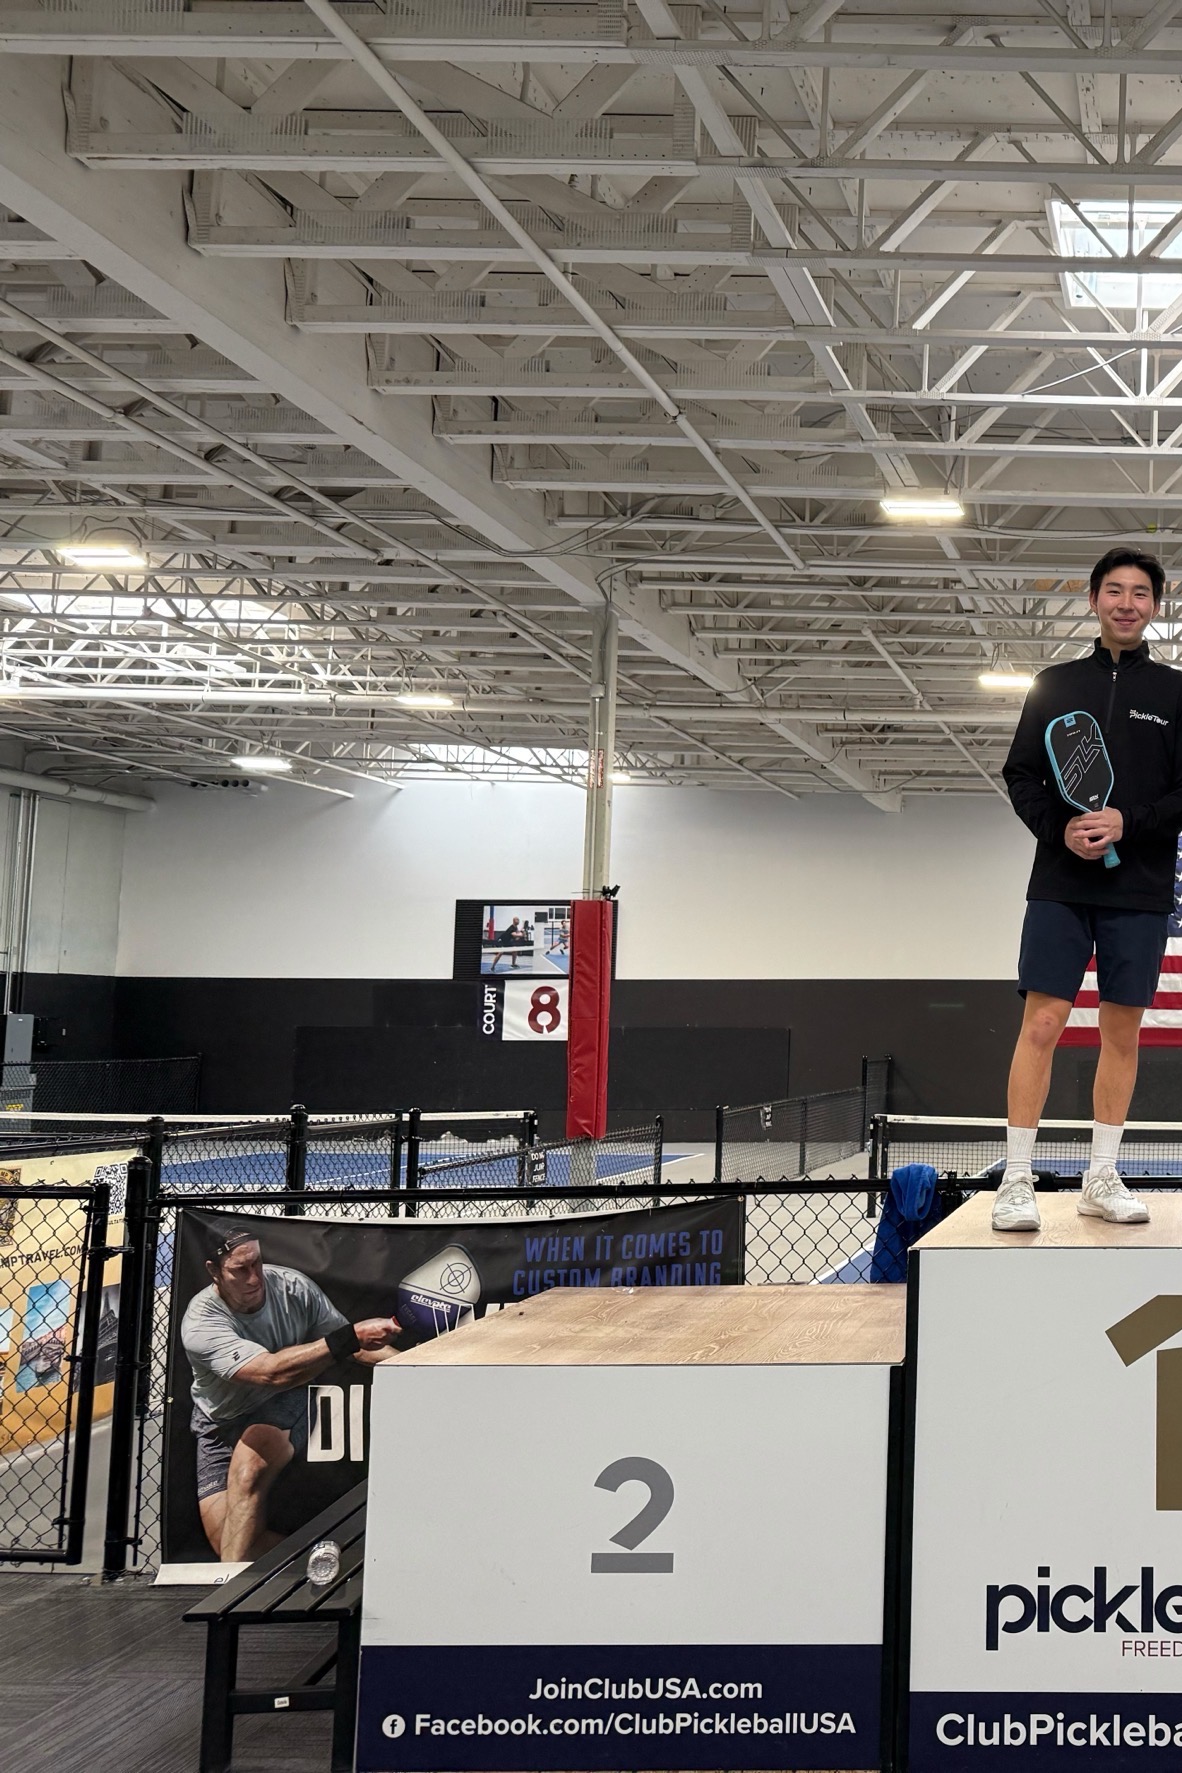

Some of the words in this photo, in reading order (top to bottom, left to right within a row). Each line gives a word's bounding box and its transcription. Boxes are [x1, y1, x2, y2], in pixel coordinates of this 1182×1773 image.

[482, 985, 497, 1035] COURT
[527, 985, 562, 1035] 8
[0, 1245, 84, 1269] MPTRAVEL.COM
[525, 1236, 585, 1263] WHEN
[595, 1234, 616, 1261] IT
[621, 1231, 692, 1260] COMES
[699, 1229, 724, 1255] TO
[512, 1267, 601, 1296] CUSTOM
[610, 1261, 721, 1287] BRANDING
[307, 1384, 366, 1462] DI
[591, 1456, 675, 1574] 2
[528, 1677, 763, 1701] JoinClubUSA.com
[414, 1711, 857, 1737] Facebook.com/ClubPickleballUSA
